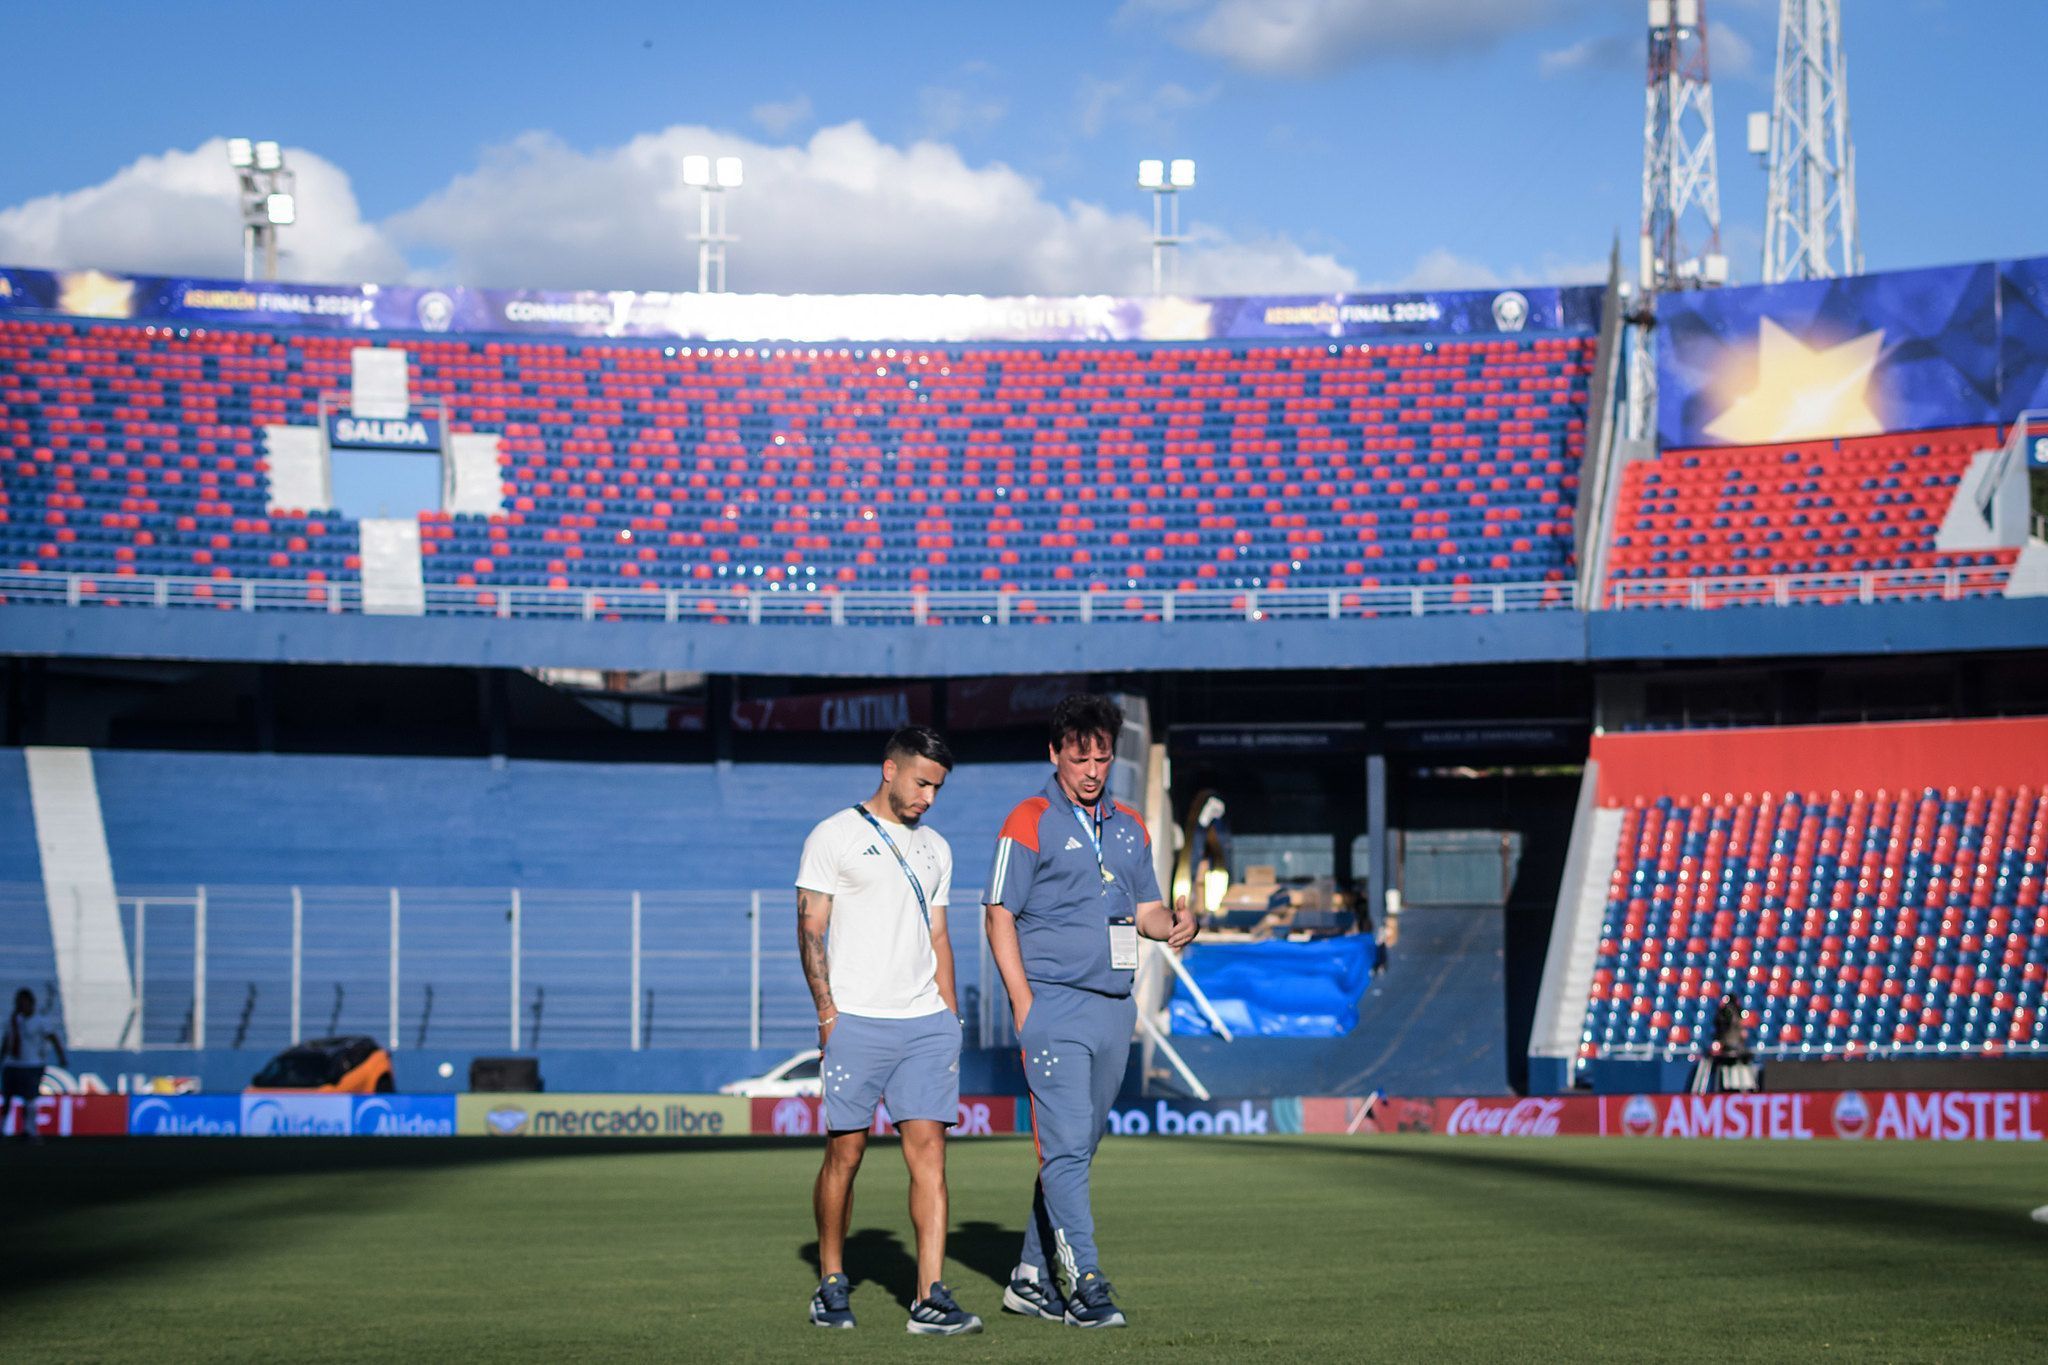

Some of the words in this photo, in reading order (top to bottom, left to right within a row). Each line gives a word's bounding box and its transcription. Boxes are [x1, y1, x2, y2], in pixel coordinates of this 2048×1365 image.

[1340, 304, 1391, 324] FINAL
[336, 419, 428, 444] SALIDA
[534, 1106, 658, 1134] mercado
[665, 1105, 723, 1134] libre
[1156, 1100, 1268, 1136] bank
[1662, 1093, 1812, 1139] AMSTEL
[1874, 1091, 2043, 1140] AMSTEL
